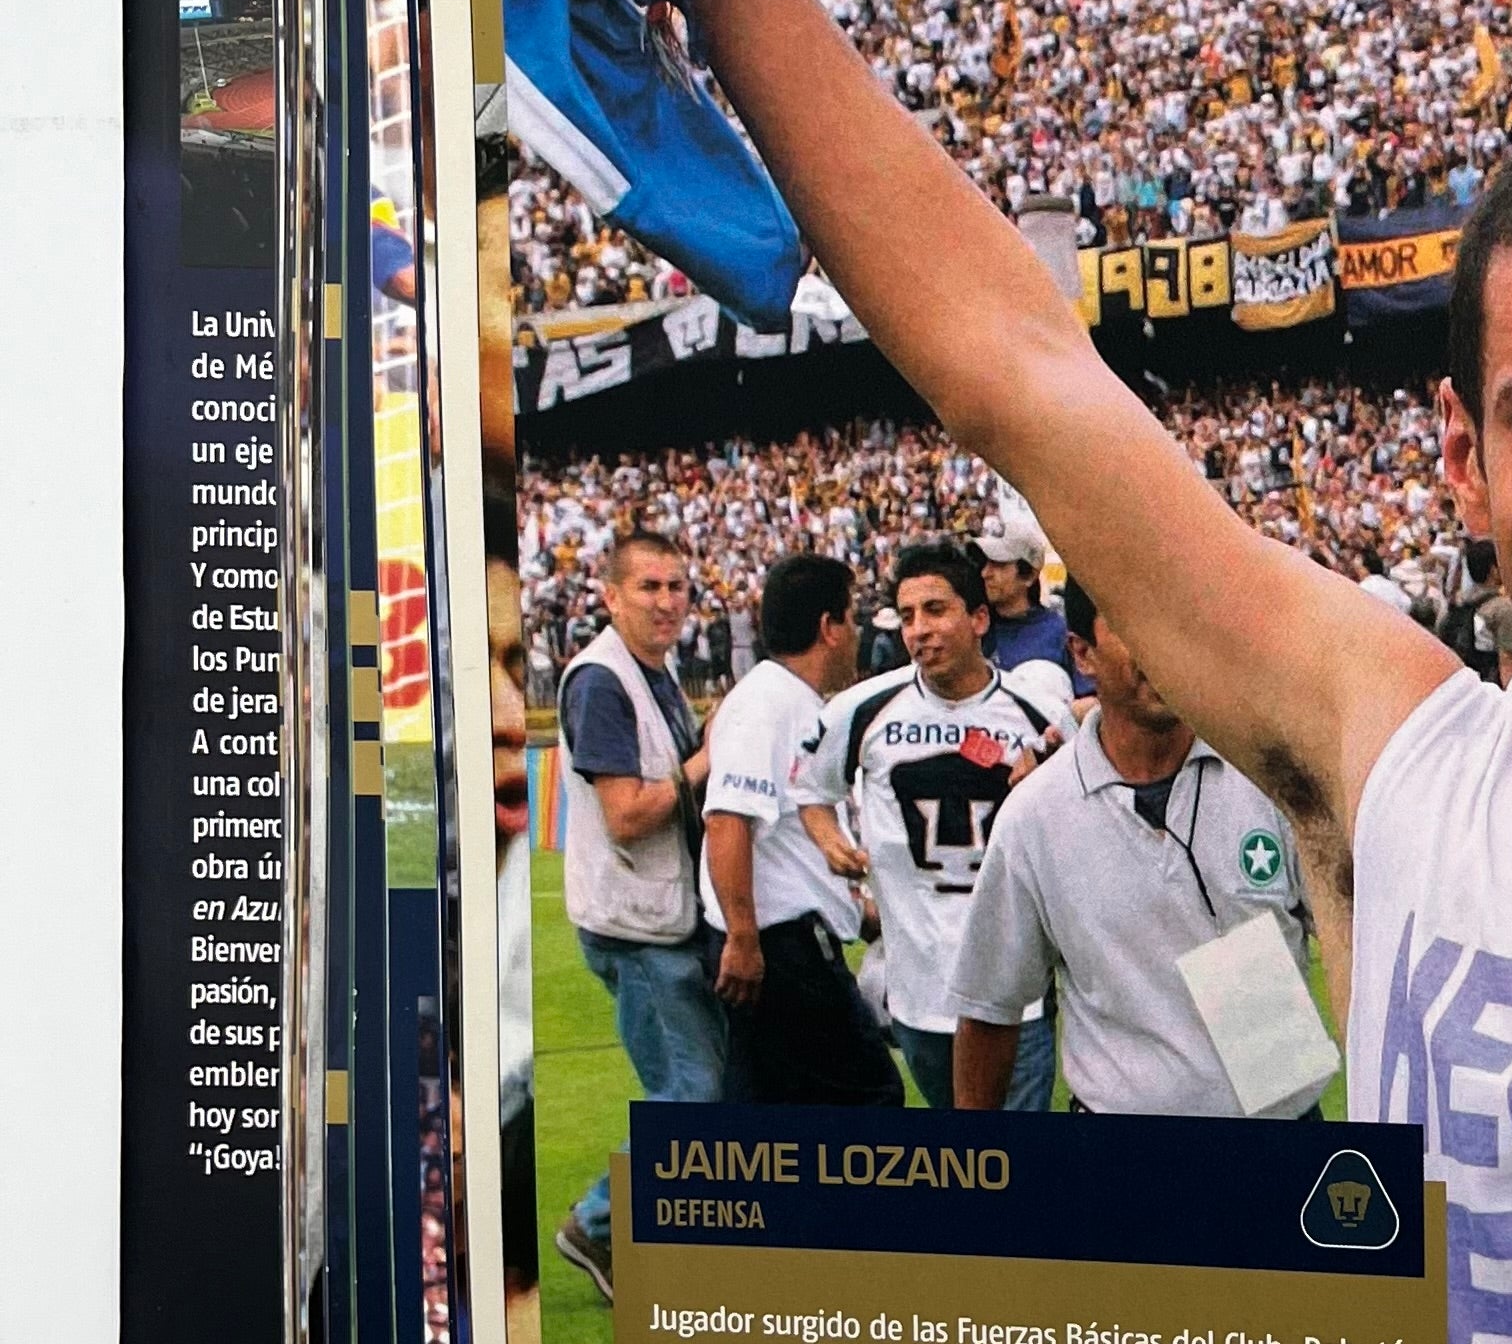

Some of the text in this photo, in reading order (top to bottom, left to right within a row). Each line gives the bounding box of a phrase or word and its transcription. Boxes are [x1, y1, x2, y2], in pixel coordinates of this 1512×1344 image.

[1342, 243, 1418, 281] AMOR
[191, 309, 219, 338] La
[191, 352, 226, 380] de
[191, 441, 226, 464] un
[189, 561, 279, 590] Y como
[191, 603, 224, 631] de
[192, 644, 228, 673] los
[192, 686, 225, 714] de
[191, 727, 210, 755] A
[192, 774, 241, 797] una
[191, 852, 249, 881] obra
[192, 898, 226, 922] en
[190, 975, 278, 1011] pasión,
[189, 1017, 265, 1046] de sus
[189, 1100, 236, 1134] hoy
[654, 1139, 1011, 1191] JAIME LOZANO
[656, 1197, 766, 1230] DEFENSA
[649, 1303, 755, 1338] Jugador
[762, 1308, 861, 1344] surgido
[869, 1312, 903, 1341] de
[912, 1314, 948, 1344] las
